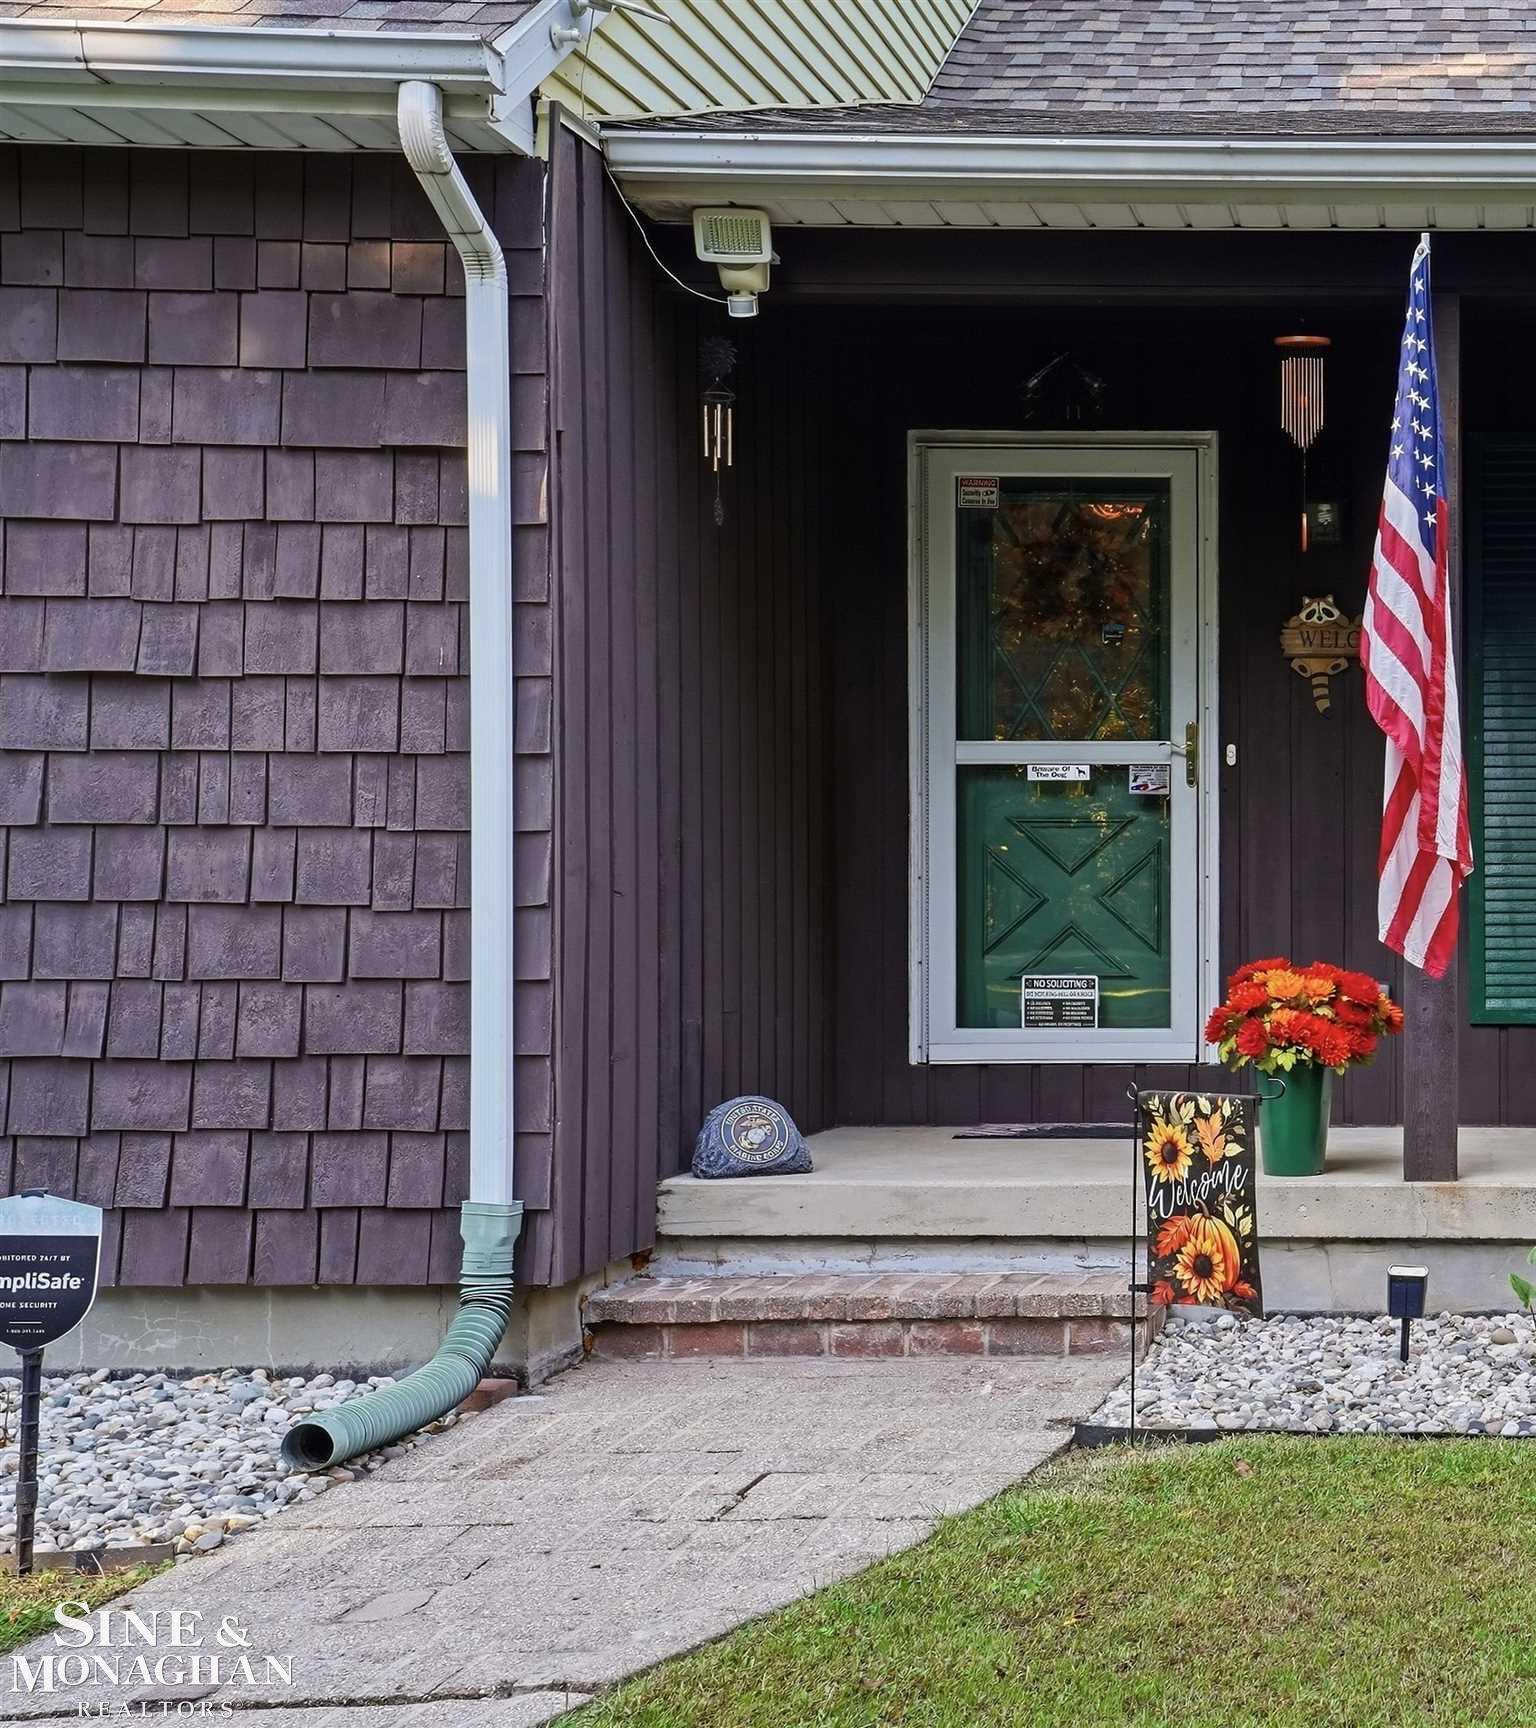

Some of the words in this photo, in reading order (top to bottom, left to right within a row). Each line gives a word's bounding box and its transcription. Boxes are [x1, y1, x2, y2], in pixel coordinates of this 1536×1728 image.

[1300, 629, 1360, 649] WELC
[1033, 979, 1046, 988] NO
[1046, 979, 1088, 989] SOLICITING
[726, 1105, 751, 1126] UNITED
[752, 1105, 781, 1122] STATES
[729, 1144, 762, 1161] MARINE
[763, 1140, 785, 1159] CORPS
[1148, 1160, 1249, 1219] Welcome
[0, 1254, 37, 1262] NITORED
[0, 1272, 82, 1293] mpliSafe
